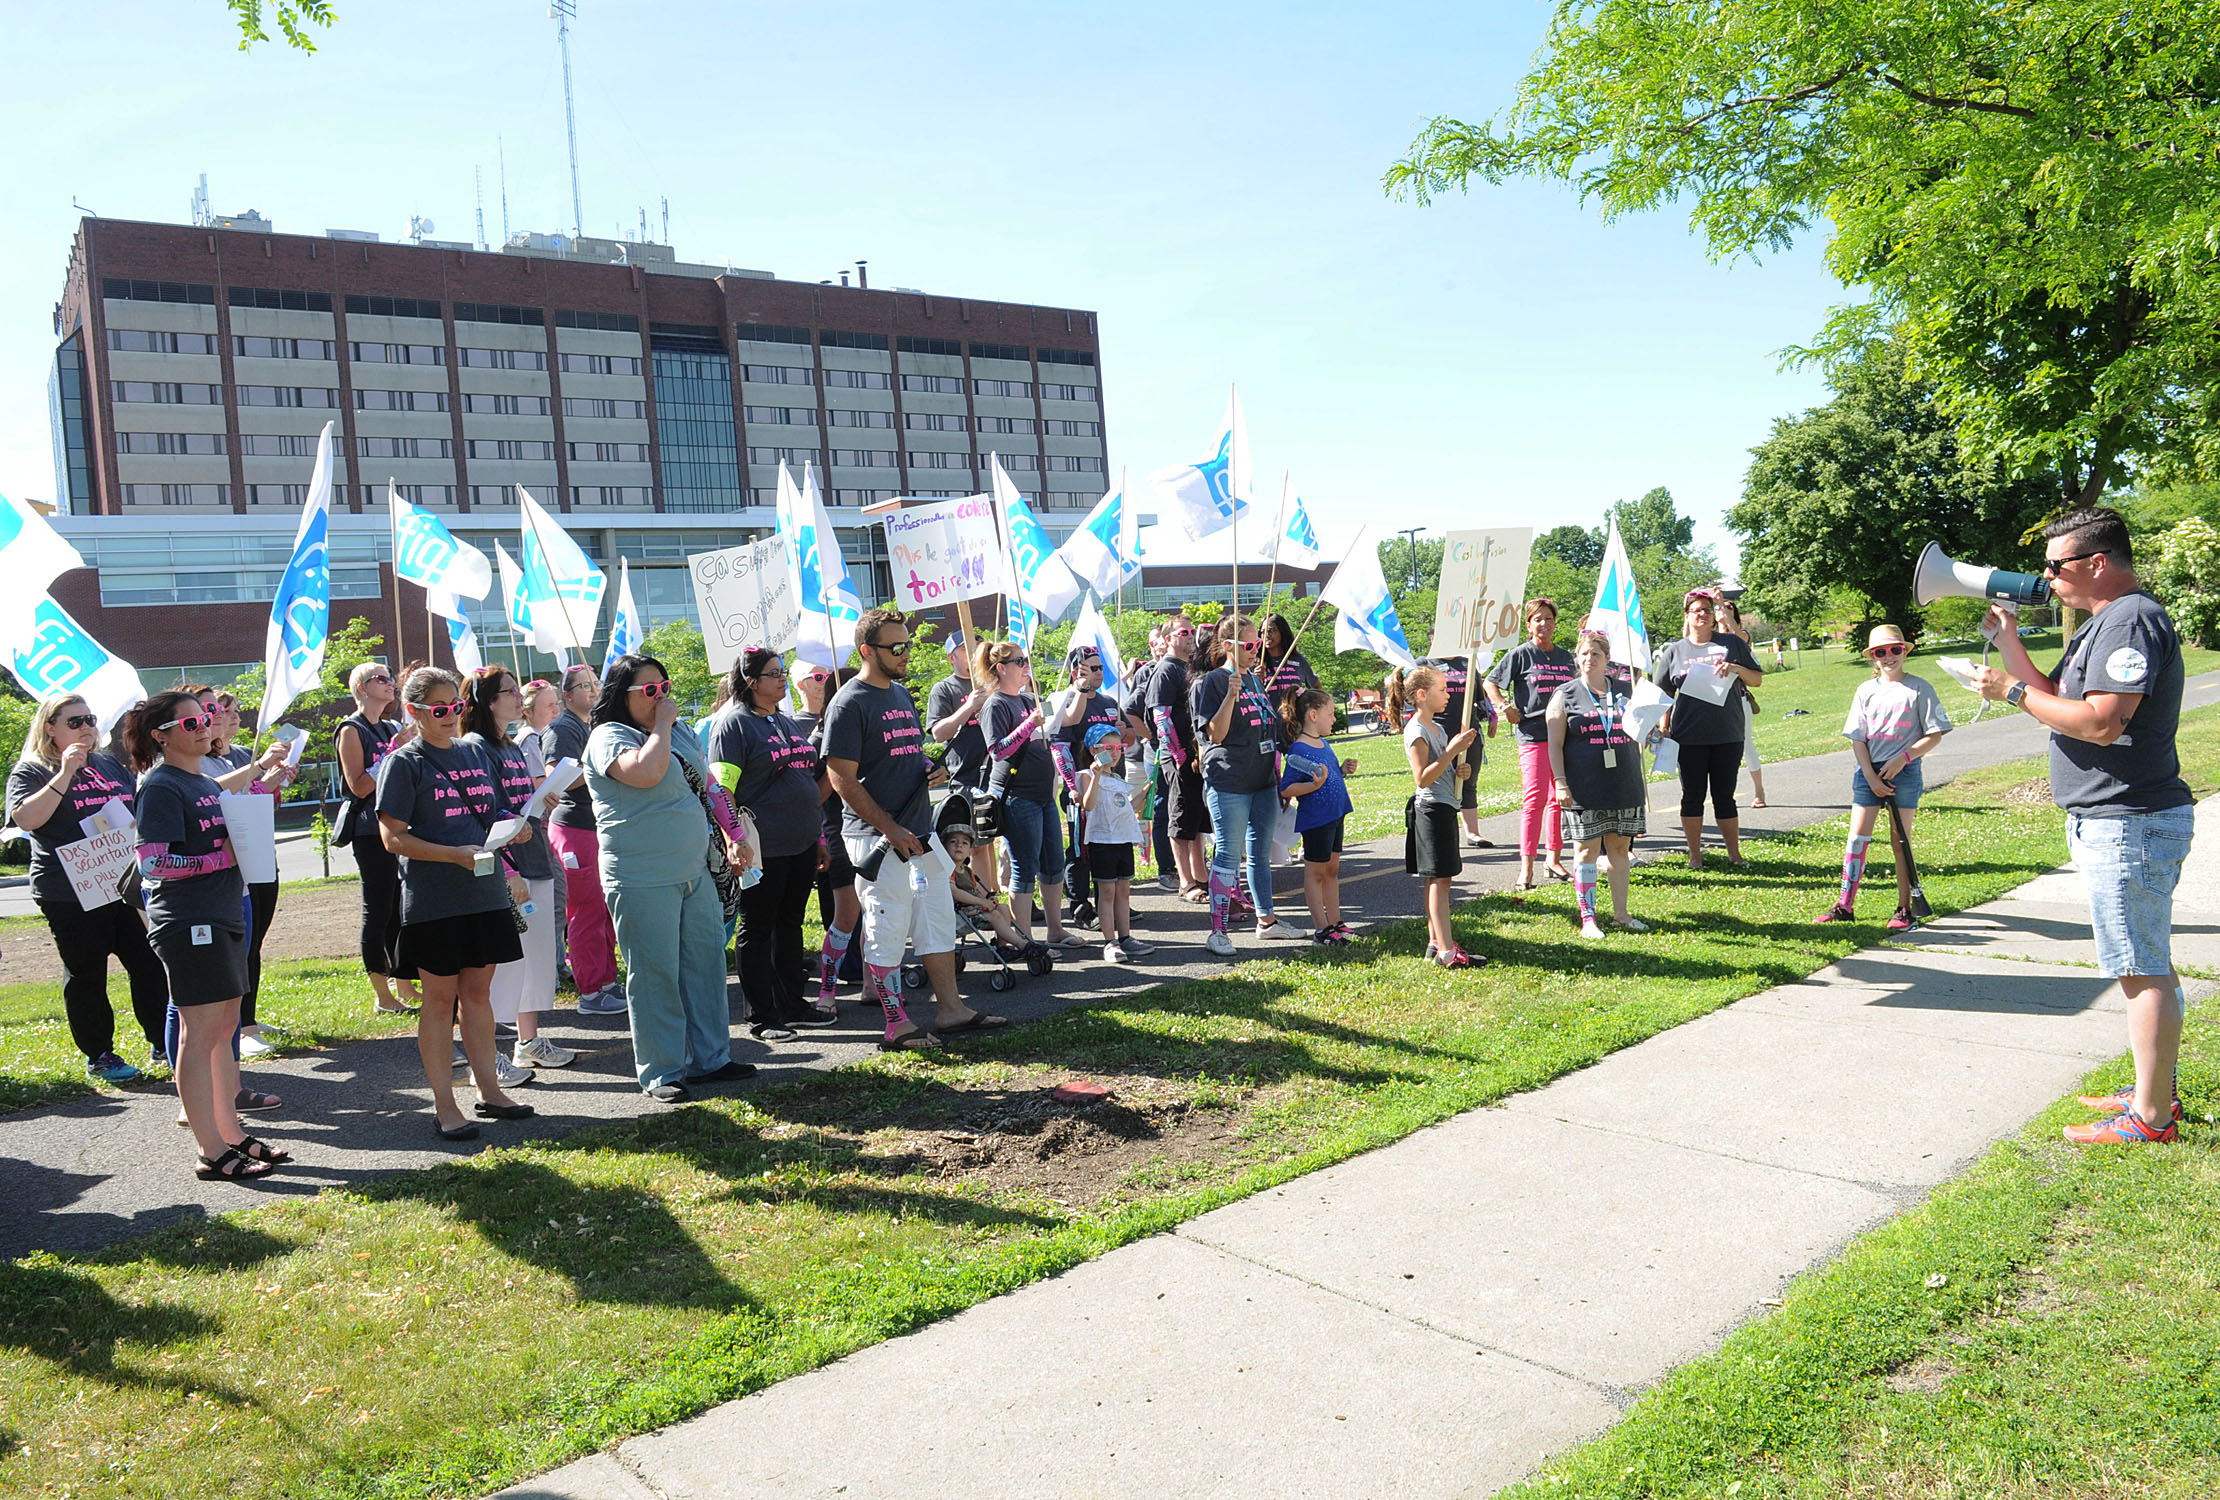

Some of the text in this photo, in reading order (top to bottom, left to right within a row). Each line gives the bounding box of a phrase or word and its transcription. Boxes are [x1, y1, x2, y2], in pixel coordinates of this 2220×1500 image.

[398, 513, 450, 584] fiq
[60, 830, 127, 862] Des ratios
[77, 880, 93, 893] ne
[94, 868, 119, 889] plus
